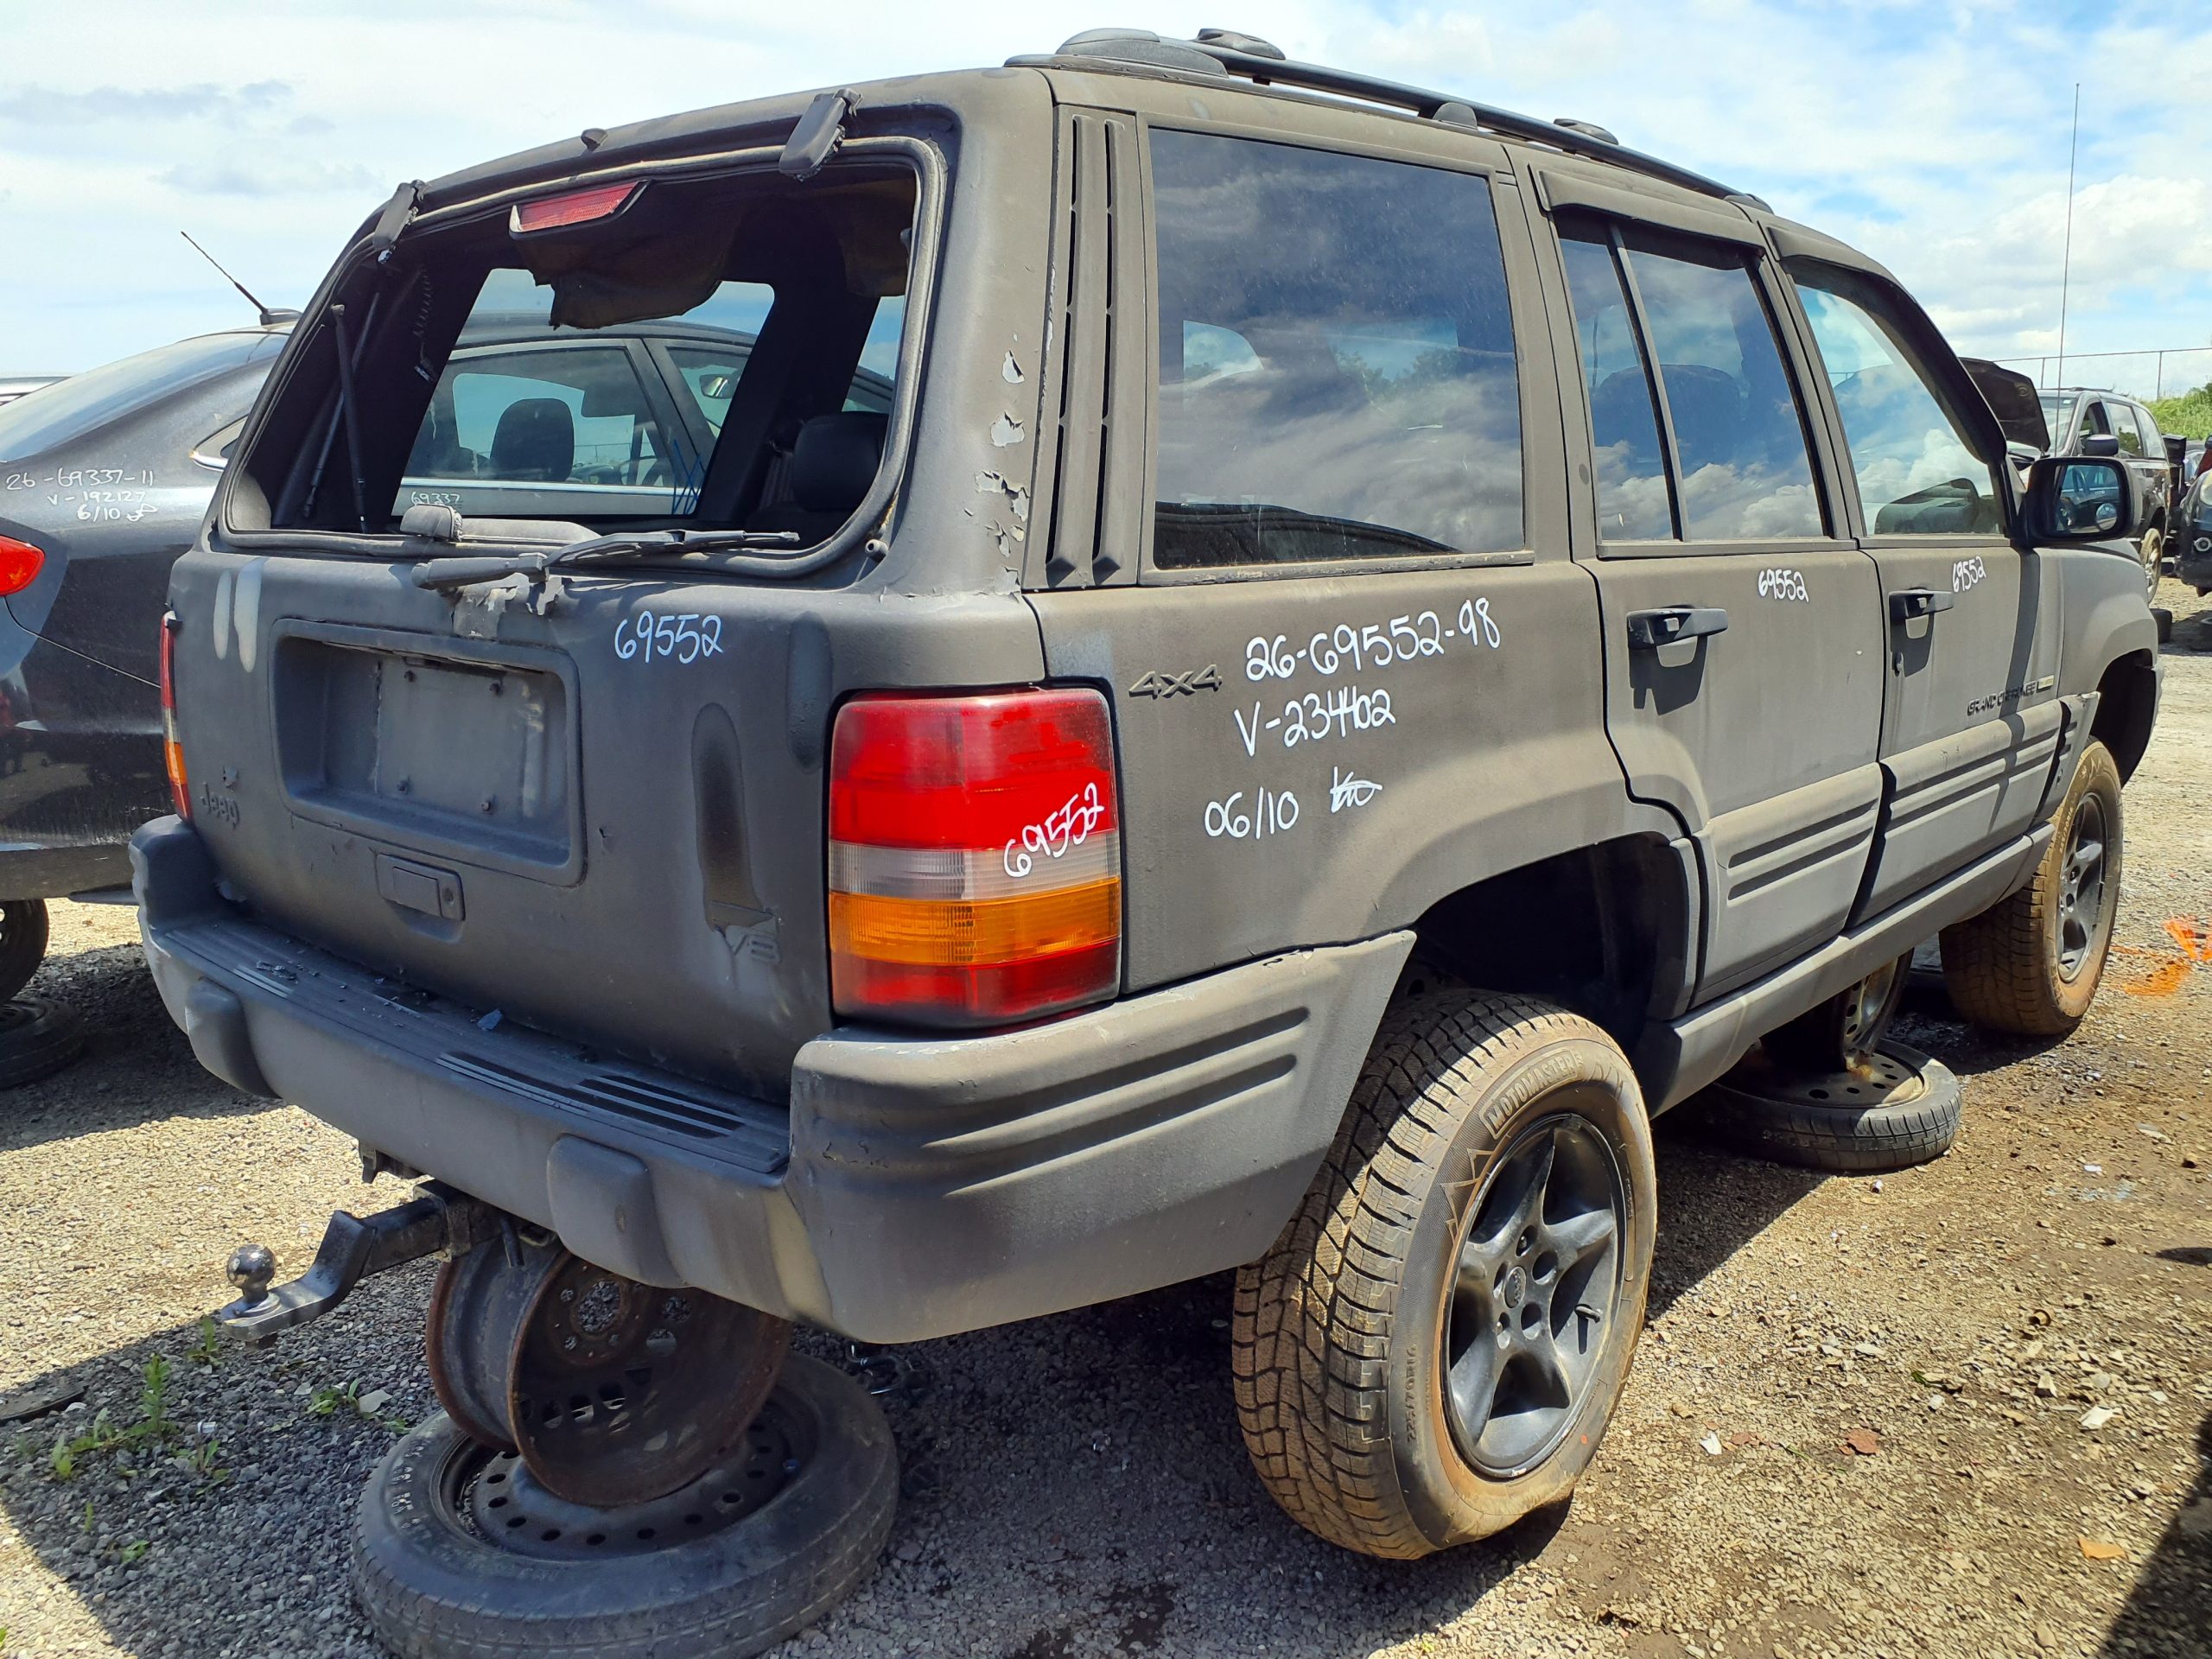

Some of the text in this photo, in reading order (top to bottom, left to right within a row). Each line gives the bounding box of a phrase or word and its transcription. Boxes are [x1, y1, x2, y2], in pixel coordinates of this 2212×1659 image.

[77, 504, 121, 522] 6/10
[410, 491, 461, 505] 69337
[1758, 569, 1809, 603] 69552
[1951, 556, 1986, 593] 69552
[614, 610, 724, 664] 69552
[1245, 597, 1501, 681] 26-69552-98
[1003, 782, 1105, 878] 69552
[1205, 785, 1300, 840] 06/10
[1487, 1052, 1579, 1129] MOTOMASTER
